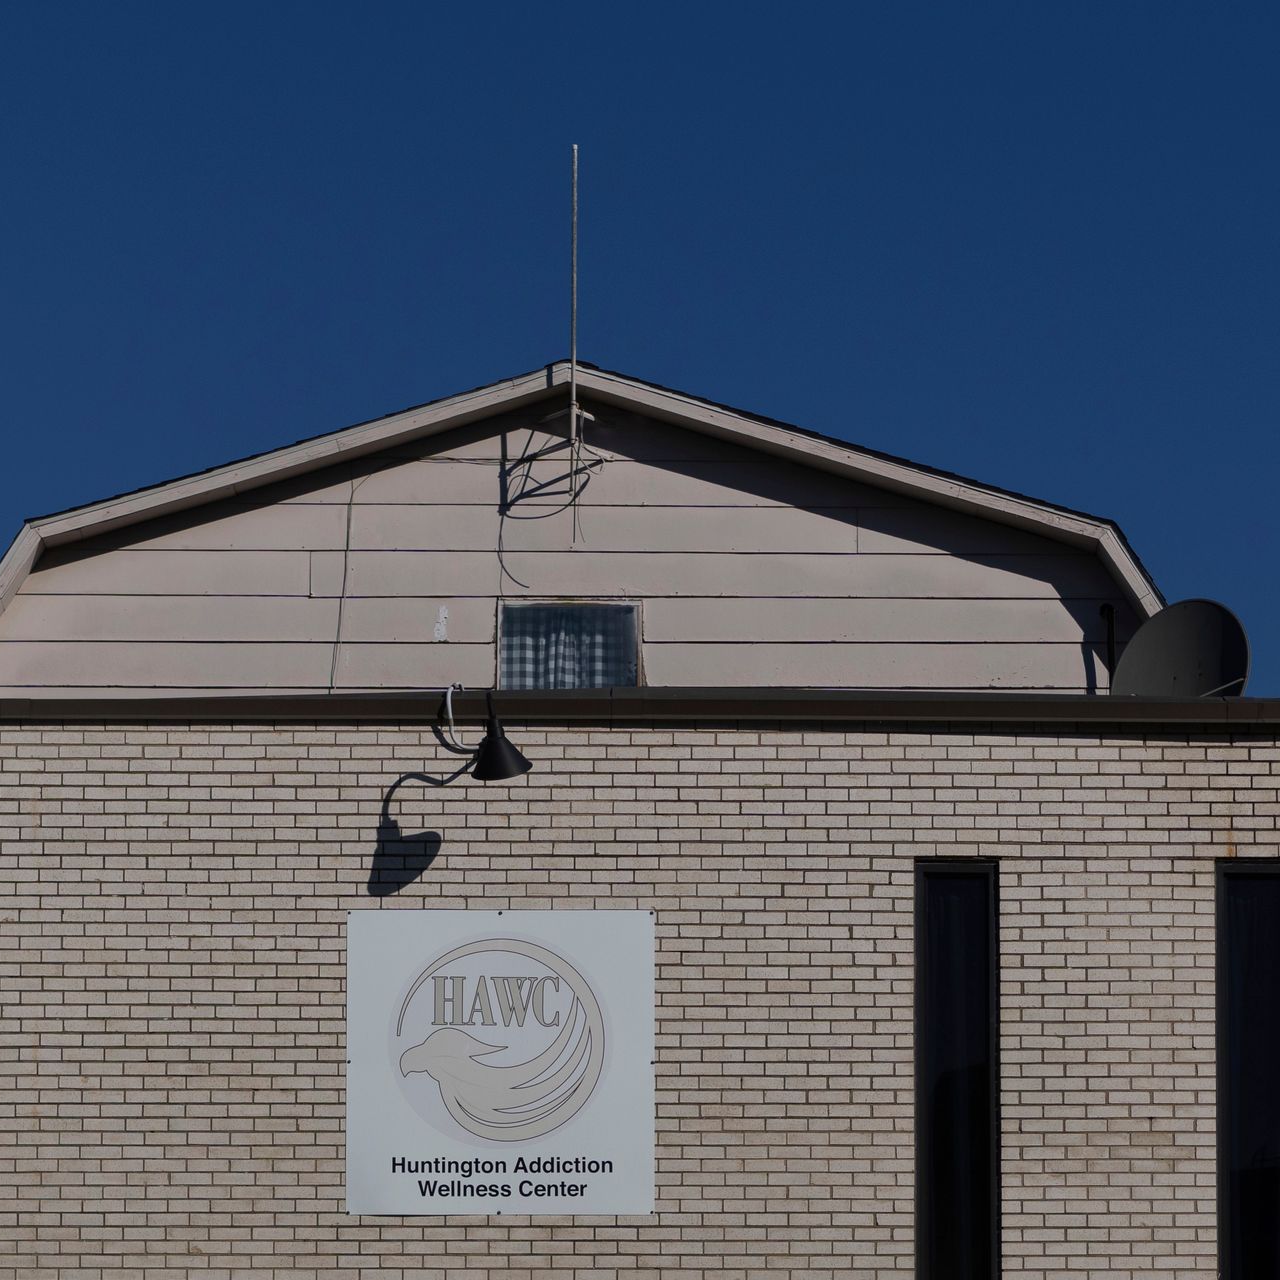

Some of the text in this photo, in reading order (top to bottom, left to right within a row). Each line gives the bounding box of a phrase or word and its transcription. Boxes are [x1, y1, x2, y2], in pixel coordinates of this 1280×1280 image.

[431, 975, 560, 1028] HAWC
[391, 1157, 614, 1178] Huntington Addiction
[418, 1180, 588, 1197] Wellness Center
